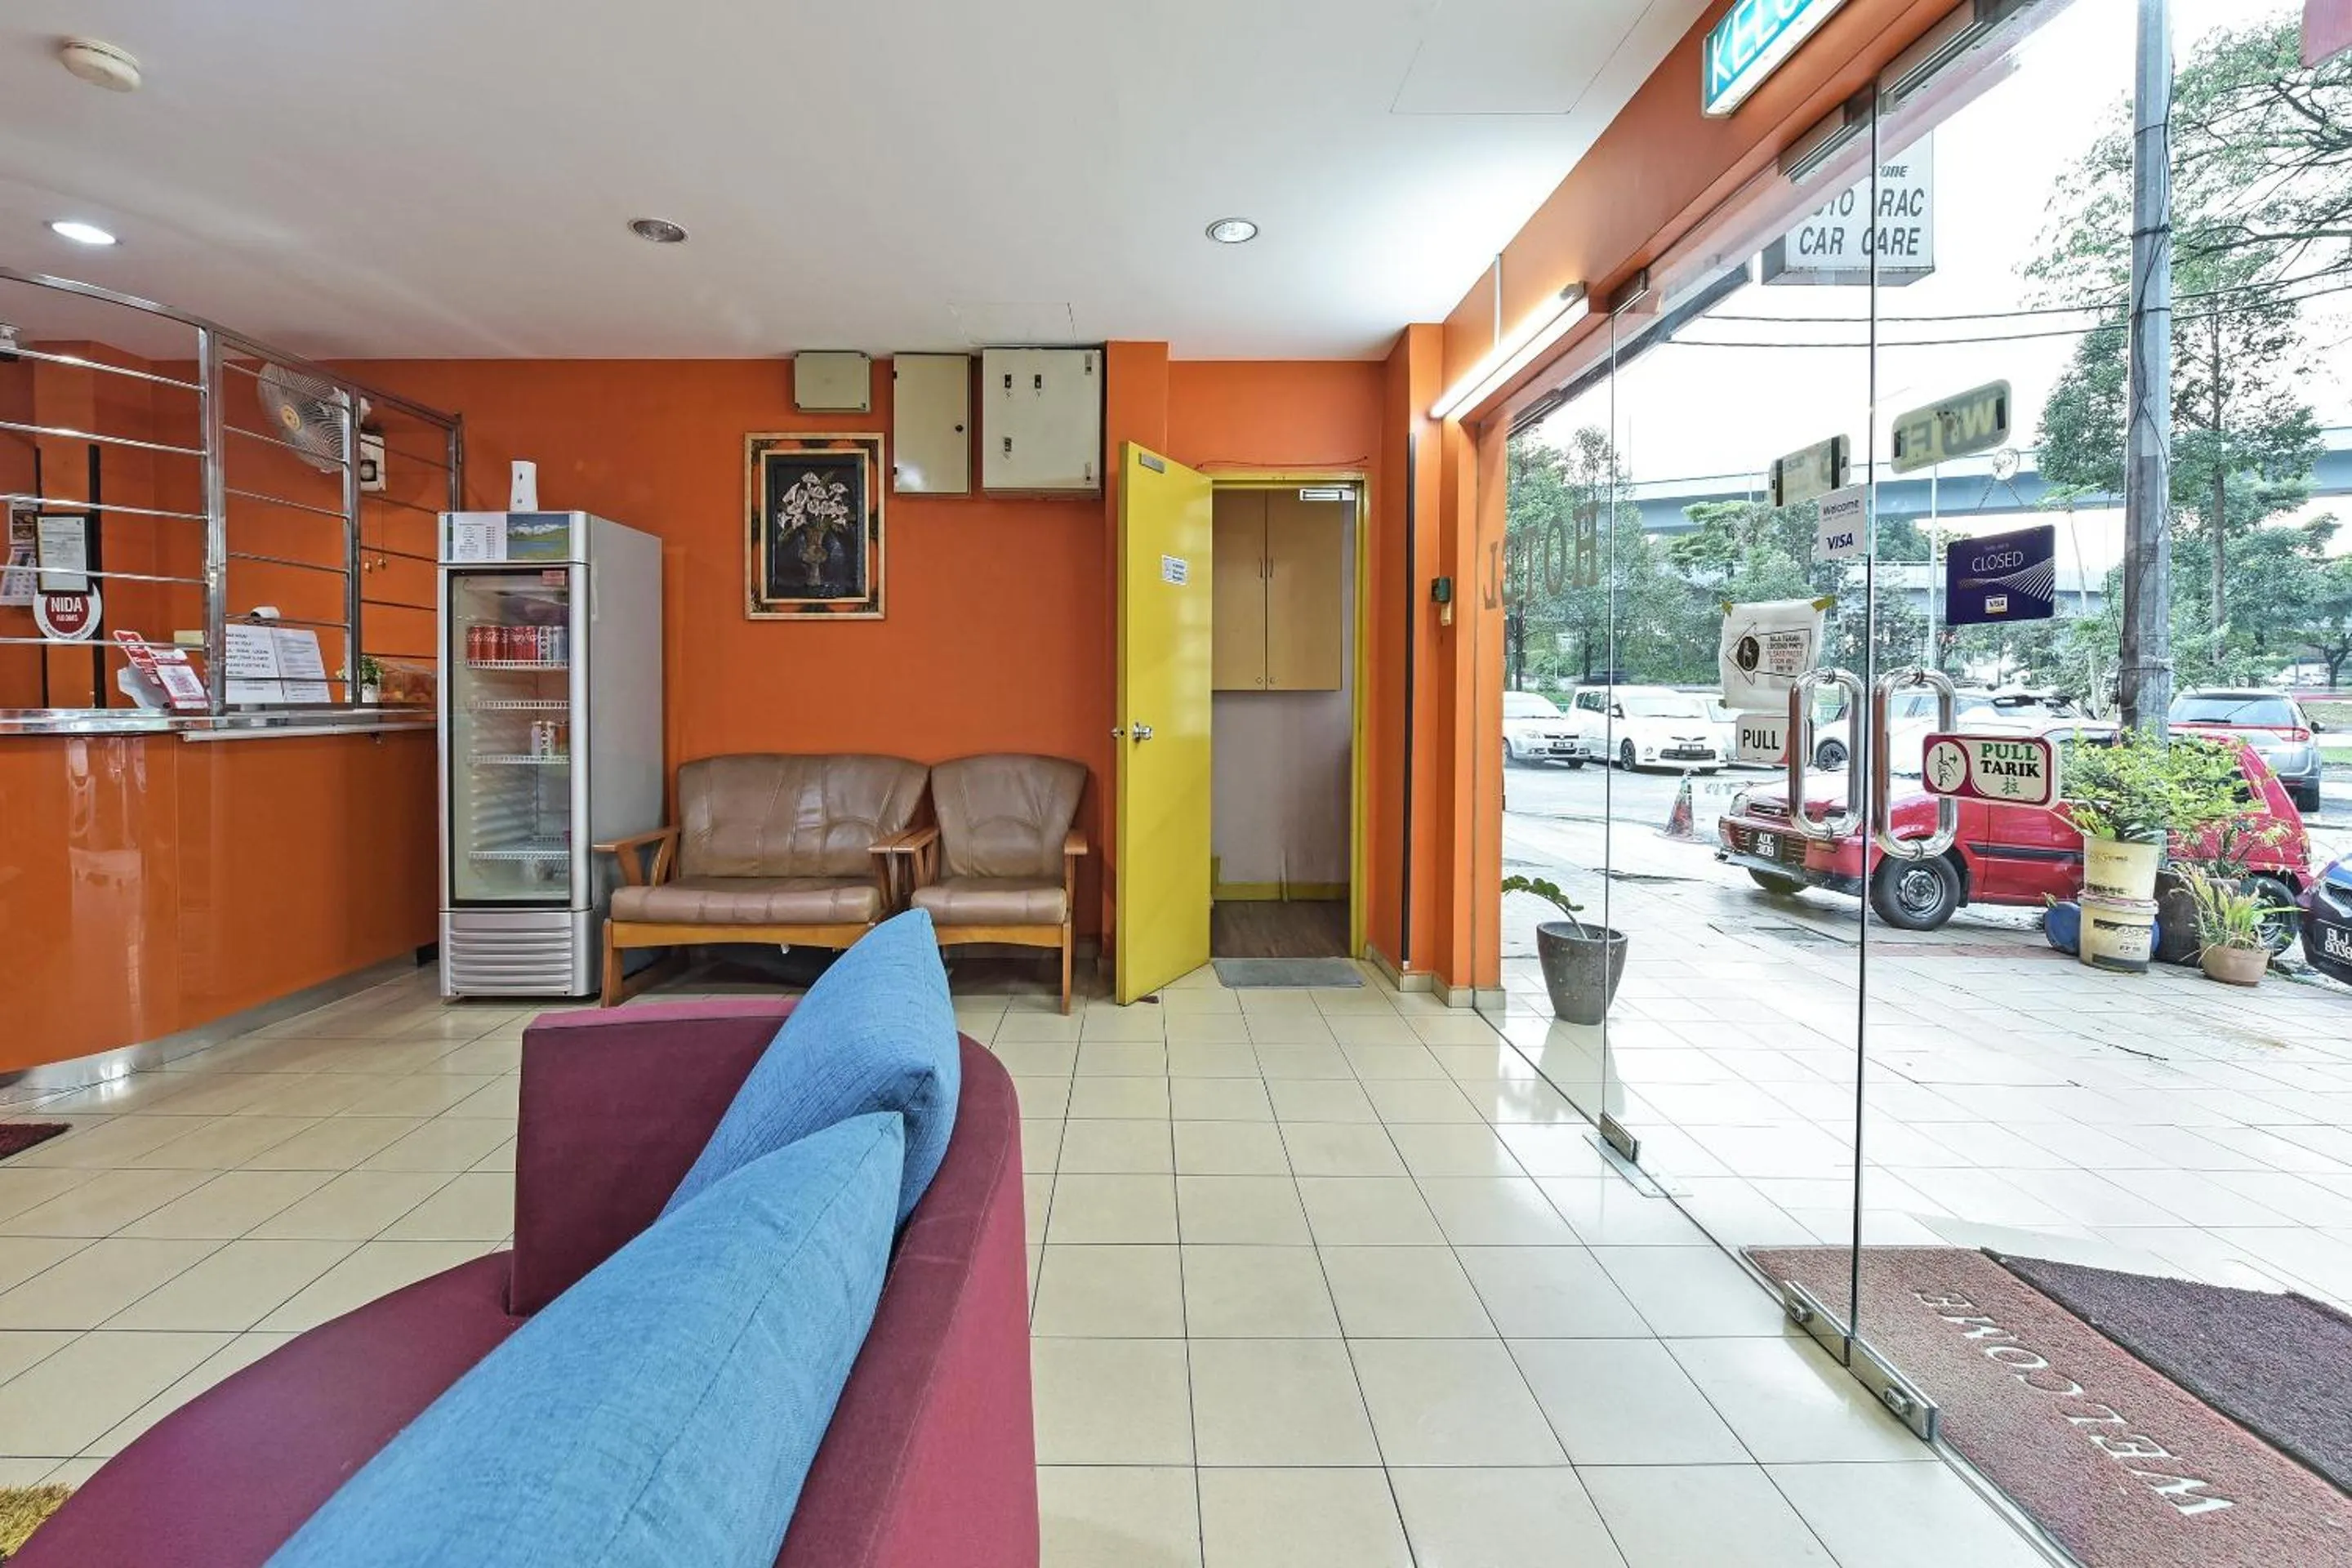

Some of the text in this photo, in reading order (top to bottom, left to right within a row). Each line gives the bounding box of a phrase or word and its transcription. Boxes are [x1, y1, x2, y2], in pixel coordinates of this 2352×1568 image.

[1873, 188, 1924, 216] RAC
[1799, 226, 1921, 256] CAR CARE
[1826, 532, 1854, 550] VISA
[1972, 551, 2024, 572] CLOSED
[51, 597, 83, 612] NIDA
[1743, 728, 1780, 750] PULL
[1981, 743, 2038, 761] PULL
[1980, 760, 2041, 778] TARIK
[2002, 777, 2020, 795] 拉
[1914, 1291, 2236, 1516] WELCOME
